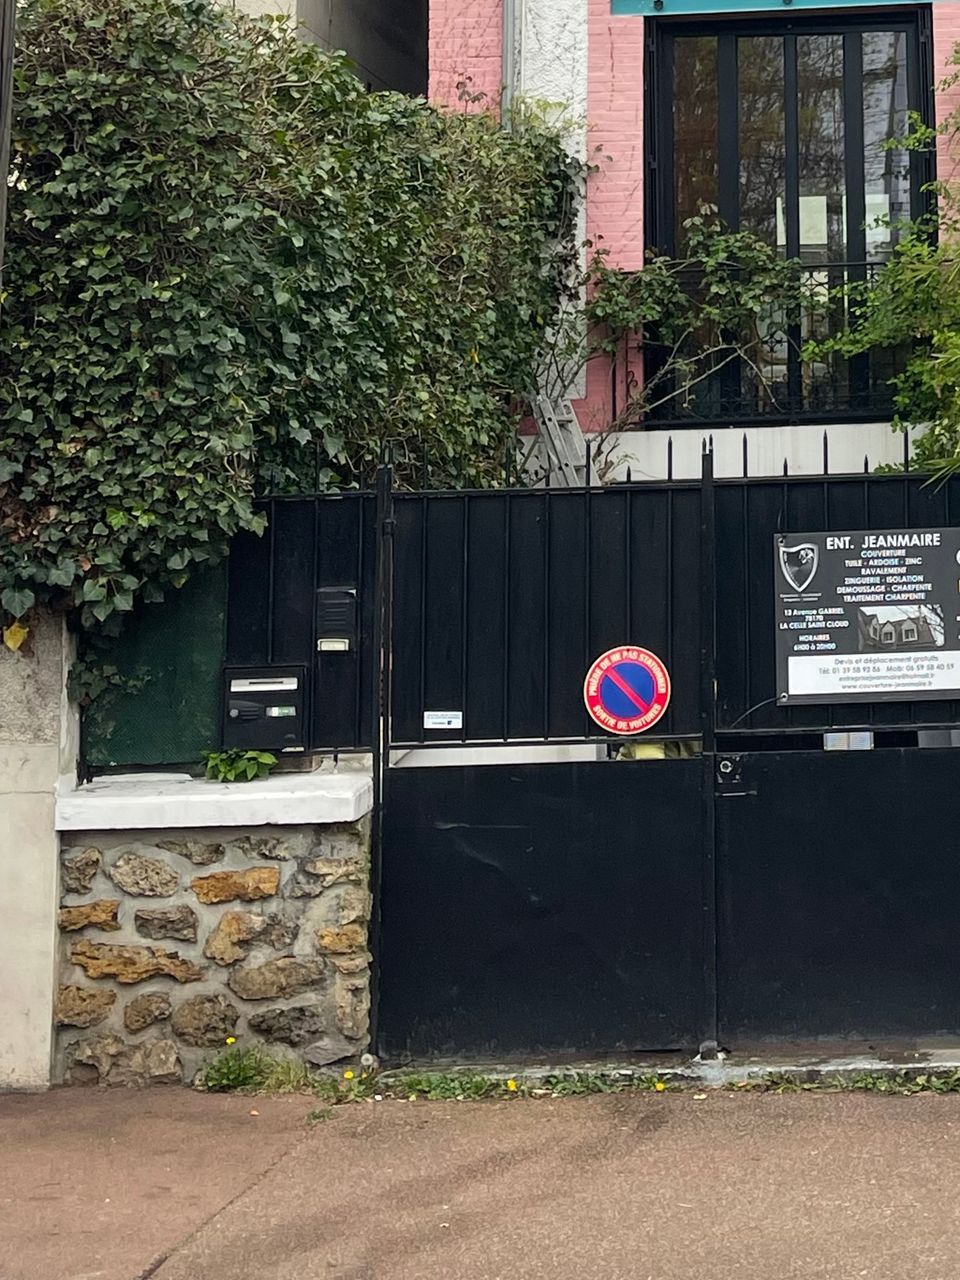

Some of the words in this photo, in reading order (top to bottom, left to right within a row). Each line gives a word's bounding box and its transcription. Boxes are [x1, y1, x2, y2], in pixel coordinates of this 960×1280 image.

[826, 536, 854, 550] ENT.
[861, 533, 941, 549] JEANMAIRE
[860, 549, 906, 558] COUVERTURE
[845, 559, 862, 567] TUILE
[868, 558, 899, 566] ARDOISE
[904, 557, 922, 565] ZINC
[861, 567, 907, 575] RAVALEMENT
[844, 576, 880, 585] ZINGUERIE
[886, 575, 924, 583] ISOLATION
[836, 585, 885, 594] DEMOUSSAGE
[891, 583, 932, 592] CHARPENTE
[843, 593, 884, 602] TRAITEMENT
[885, 592, 925, 601] CHARPENTE
[793, 608, 817, 616] Avenue
[818, 607, 844, 615] GABRIEL
[600, 658, 611, 669] DE
[609, 653, 621, 662] NE
[622, 650, 638, 660] PAS
[863, 656, 912, 665] déplacement
[913, 655, 939, 663] gratuits
[592, 704, 617, 728] SORTIE
[617, 721, 628, 730] DE
[629, 704, 662, 729] VOITURES
